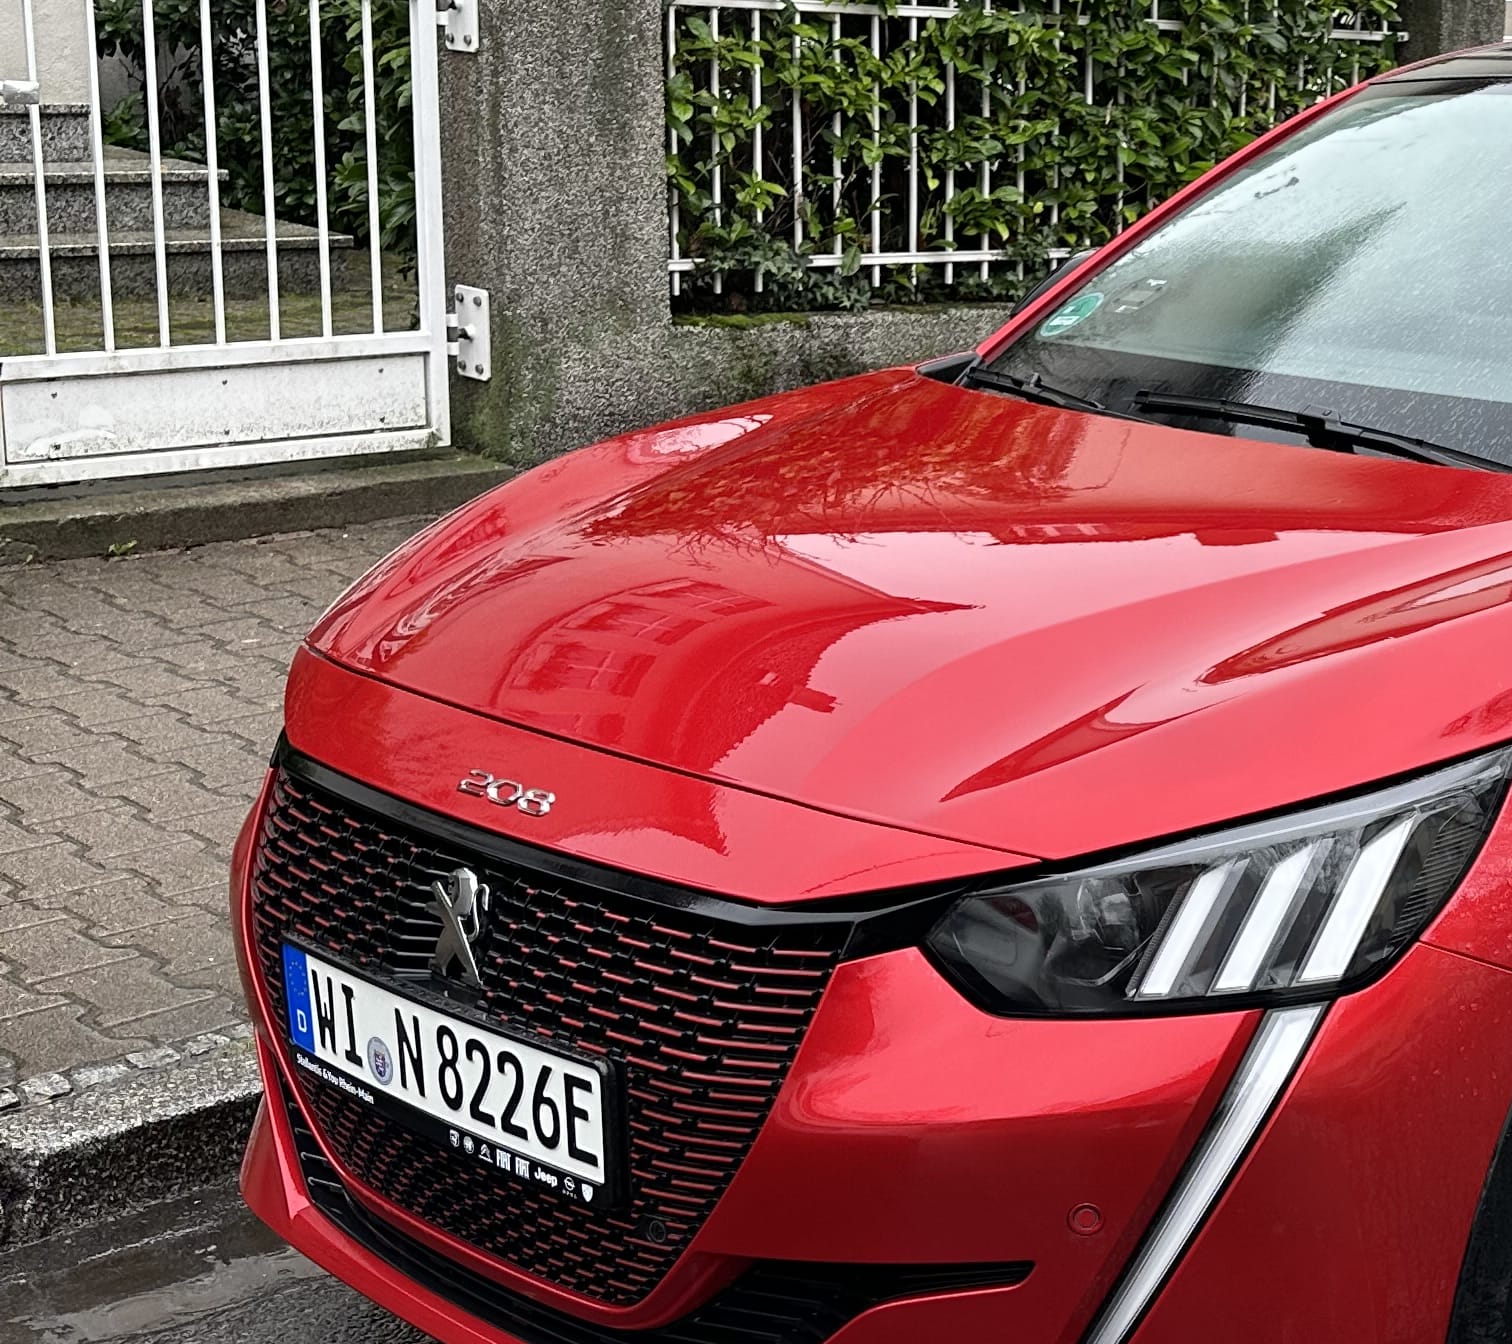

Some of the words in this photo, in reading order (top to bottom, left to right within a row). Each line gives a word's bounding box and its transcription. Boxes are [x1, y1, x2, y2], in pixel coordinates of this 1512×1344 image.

[457, 769, 555, 817] 208
[297, 1008, 307, 1033] D
[311, 968, 363, 1068] WI
[534, 1166, 558, 1188] Jeep
